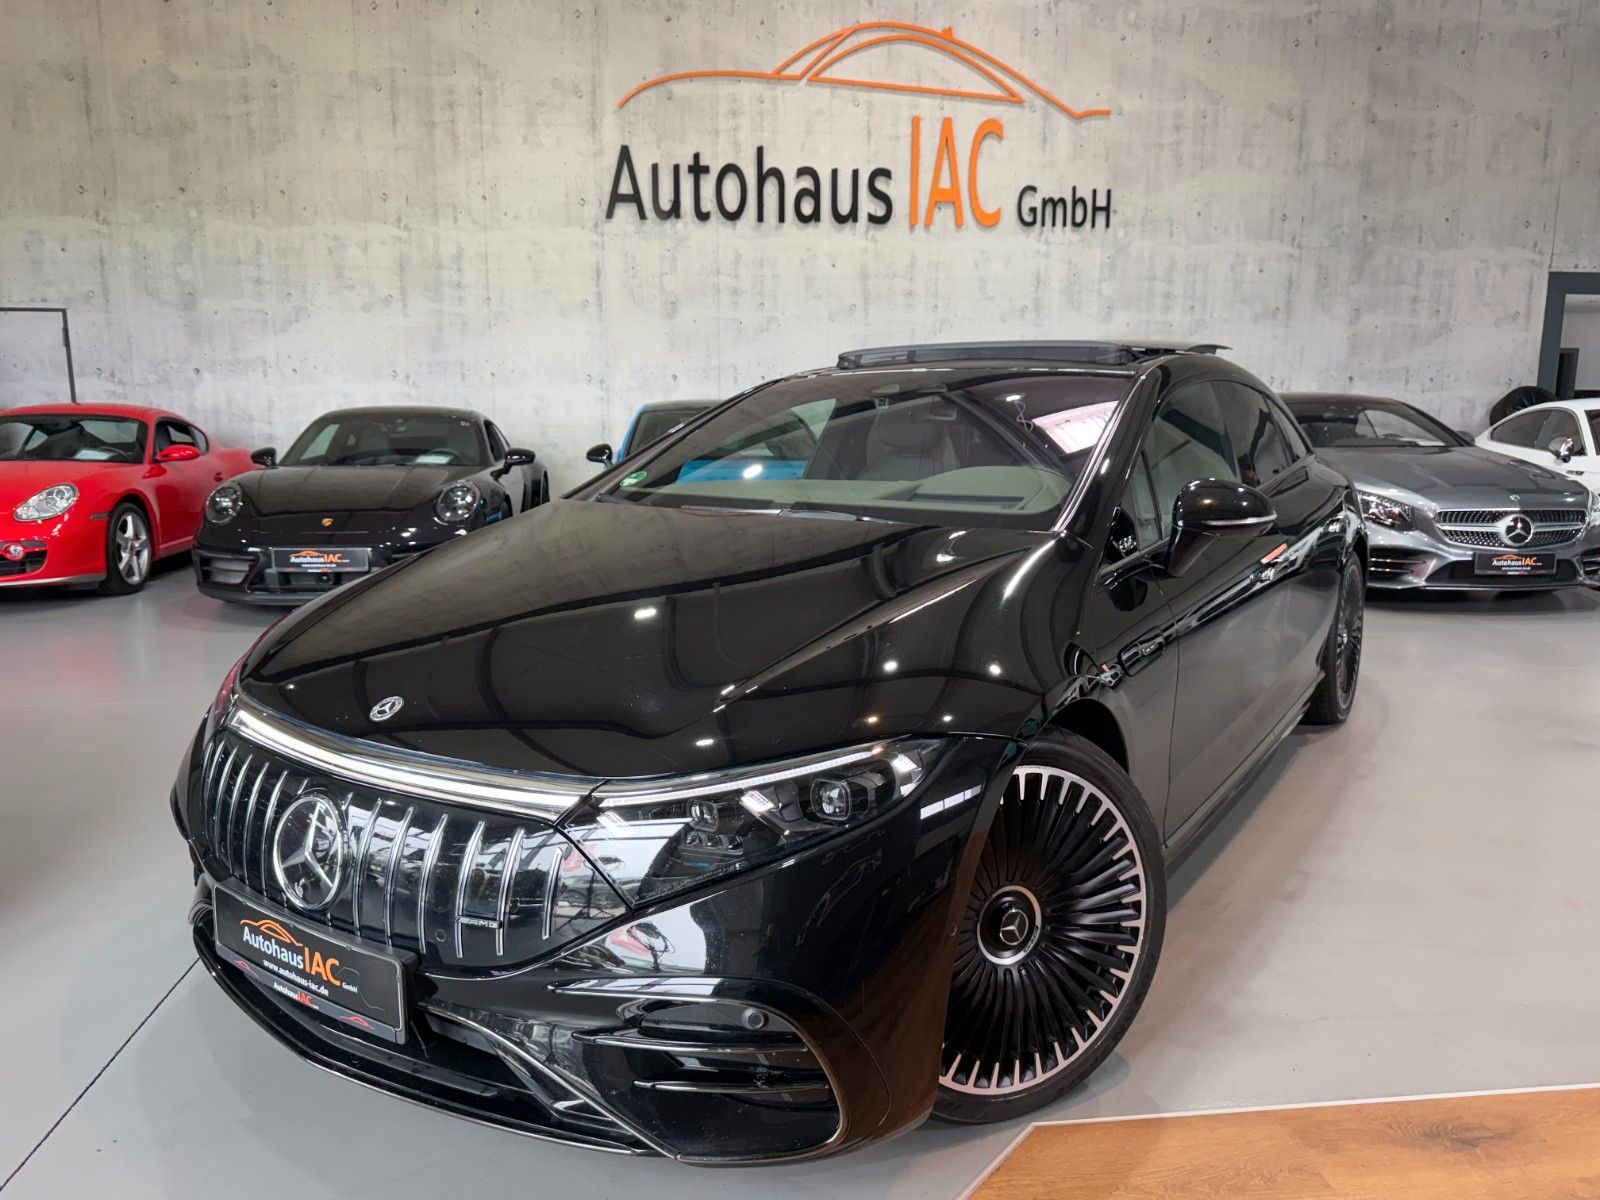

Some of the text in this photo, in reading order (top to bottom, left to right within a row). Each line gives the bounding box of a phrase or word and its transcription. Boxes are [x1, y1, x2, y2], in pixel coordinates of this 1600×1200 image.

[605, 115, 1112, 229] Autohaus IAC GmbH
[1521, 557, 1537, 565] IAC
[243, 925, 304, 969] Autohaus
[304, 947, 341, 987] IAC
[262, 959, 329, 996] www.autohaus-iac.de
